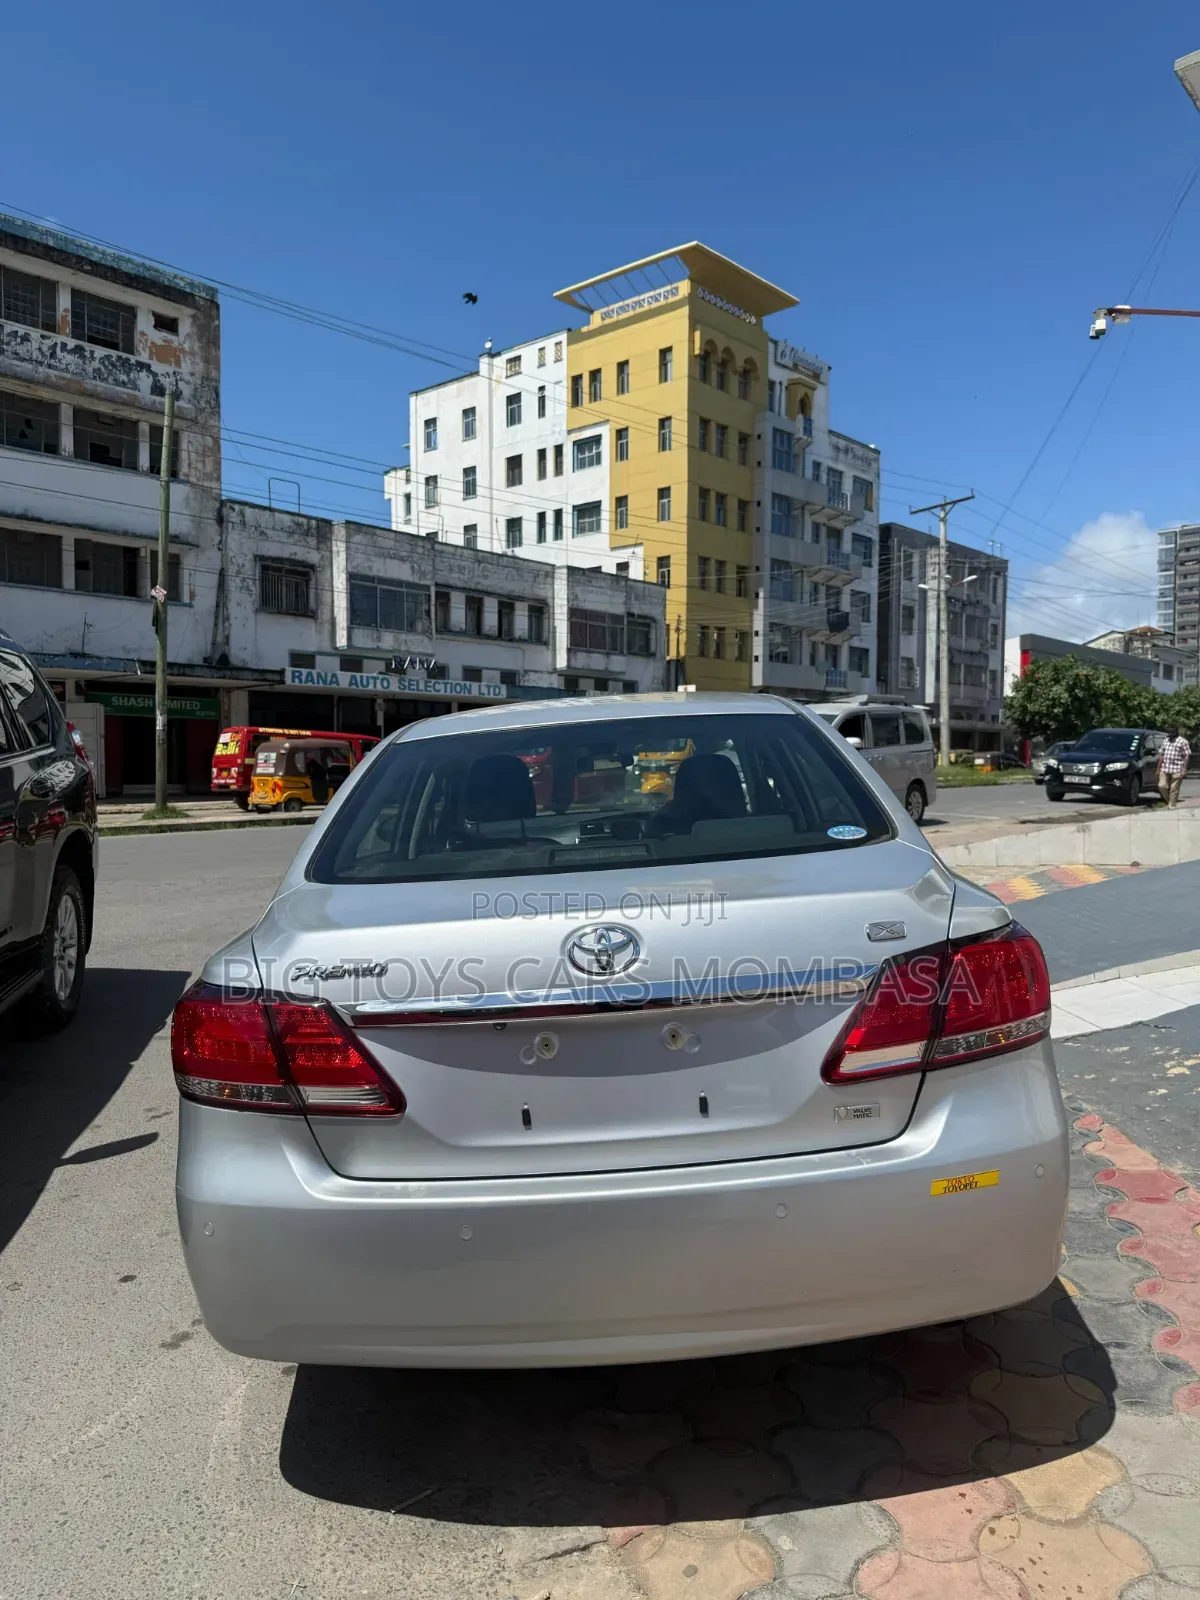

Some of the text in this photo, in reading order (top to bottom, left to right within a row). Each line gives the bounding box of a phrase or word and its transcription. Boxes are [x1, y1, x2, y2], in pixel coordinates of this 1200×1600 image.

[391, 656, 439, 672] RANA
[291, 669, 504, 697] RANA AUTO SELECTION LTD.
[111, 696, 201, 710] SHASH MITED
[290, 962, 389, 982] PREMIO
[943, 1181, 979, 1193] TOYOPET
[947, 1175, 975, 1187] TOKYO
